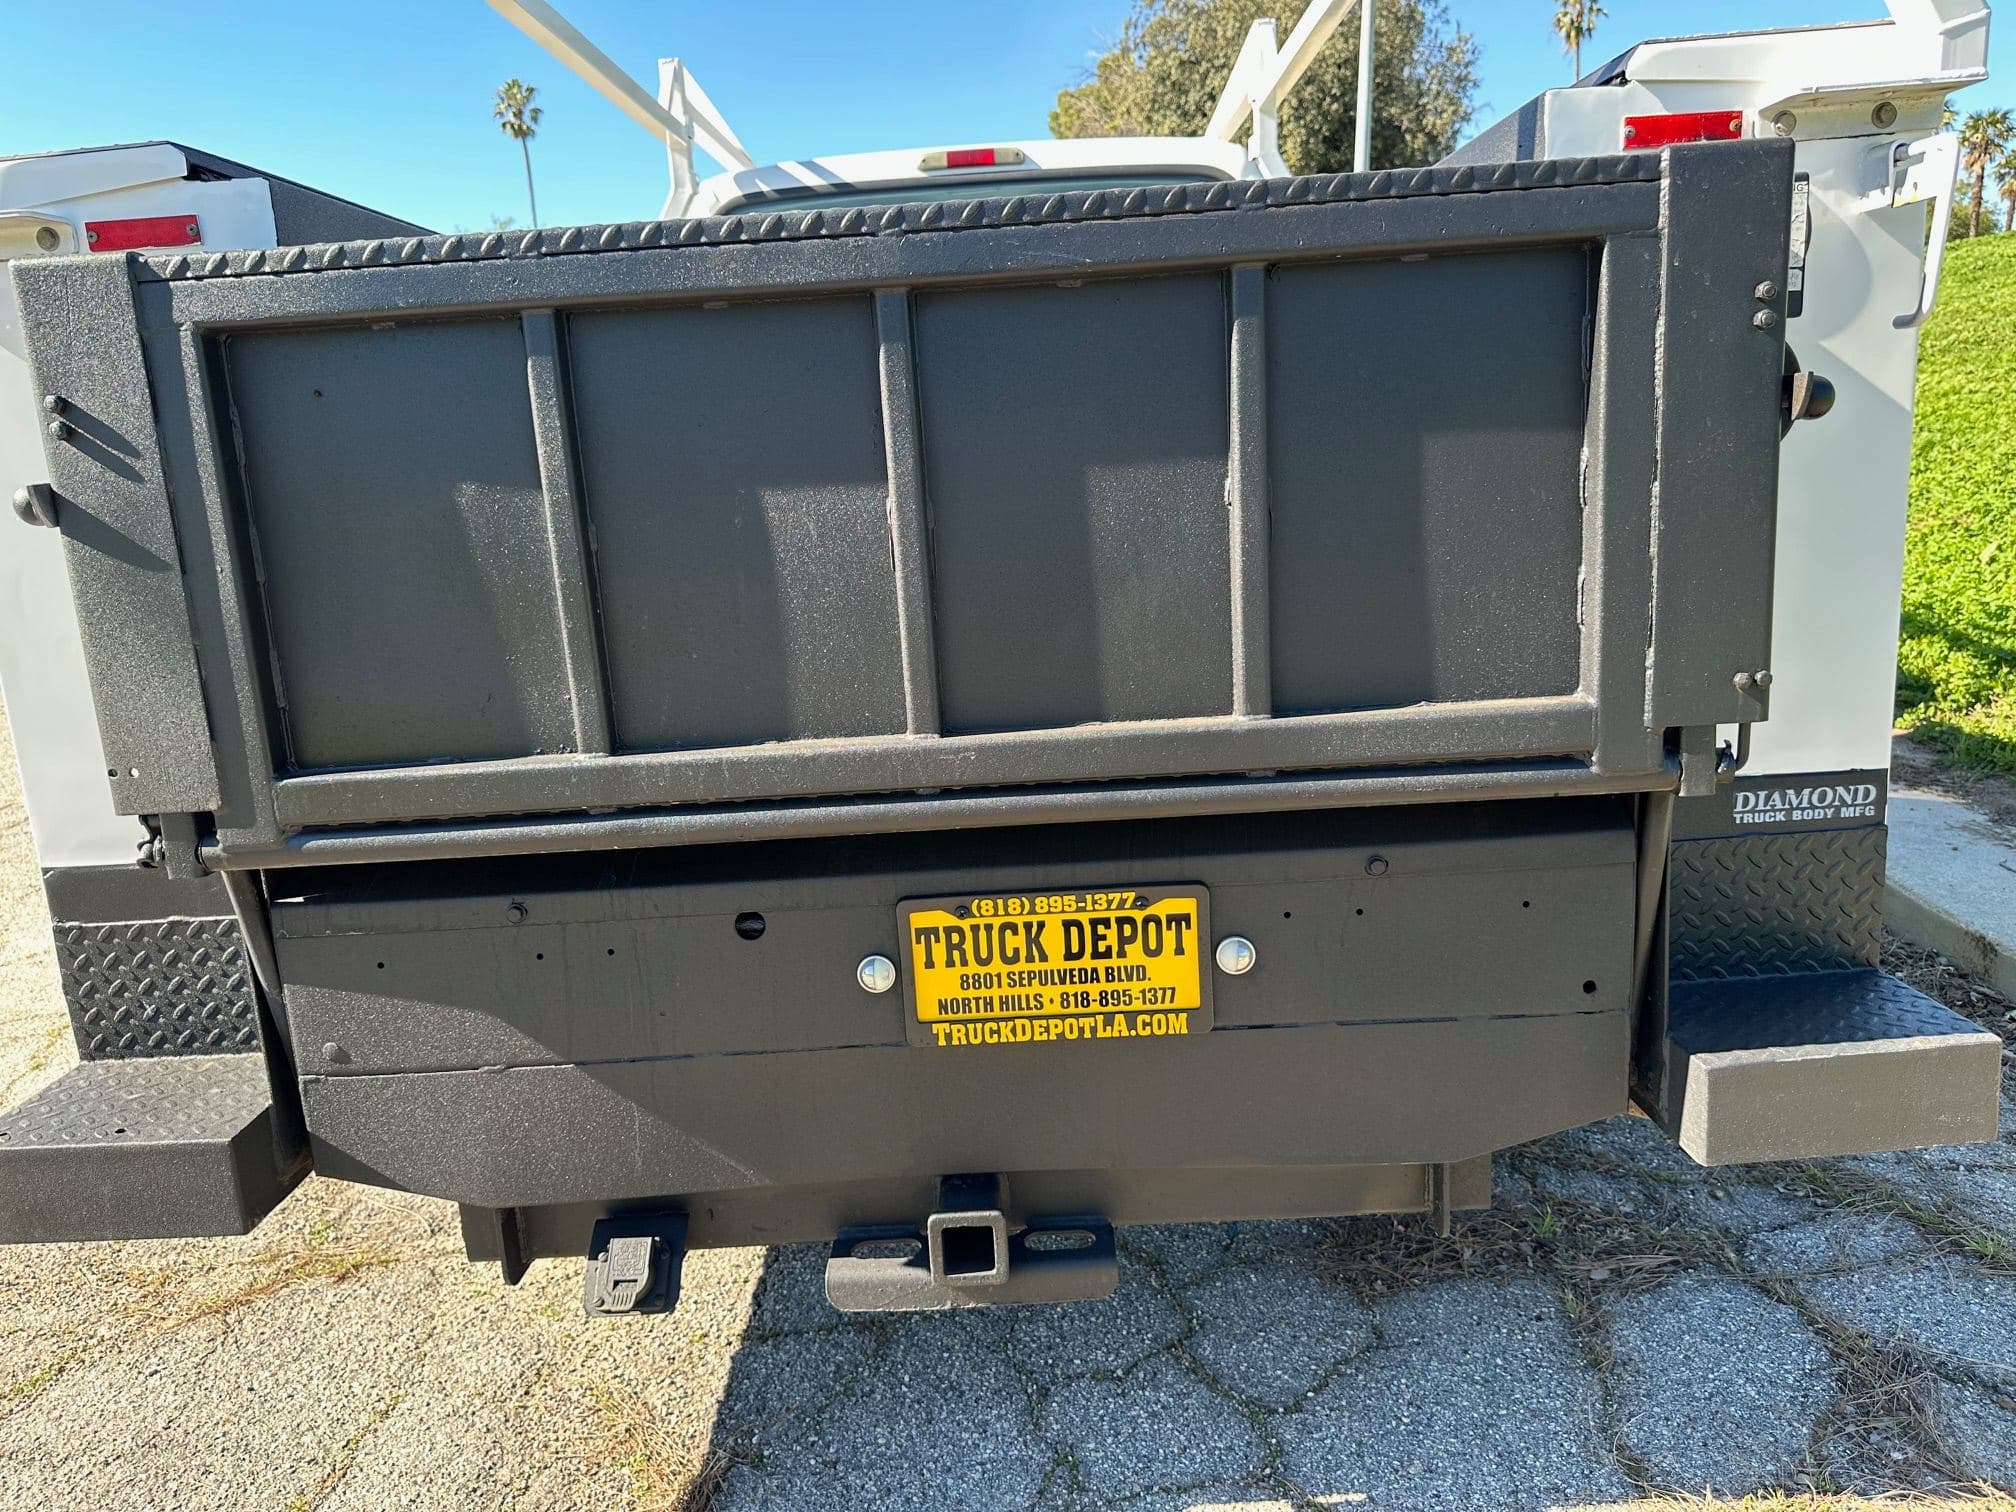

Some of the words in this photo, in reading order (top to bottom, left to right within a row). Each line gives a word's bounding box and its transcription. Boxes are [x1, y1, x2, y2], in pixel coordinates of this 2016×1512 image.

[1733, 784, 1877, 812] DIAMOND
[1733, 811, 1786, 824] TRUCK
[1792, 808, 1835, 821] BODY
[1840, 805, 1875, 818] MFG
[971, 897, 1030, 917] (818)
[1034, 892, 1136, 914] 895-1377
[915, 920, 1048, 969] TRUCK
[1062, 912, 1191, 961] DEPOT
[960, 972, 1002, 991] 8801
[1006, 967, 1101, 988] SEPULVEDA
[1105, 965, 1151, 983] BLVD.
[938, 996, 994, 1015] NORTH
[999, 993, 1044, 1013] HILLS
[1060, 987, 1176, 1009] 818-895-1377
[931, 1012, 1188, 1046] TRUCKDEPOTLA.COM
